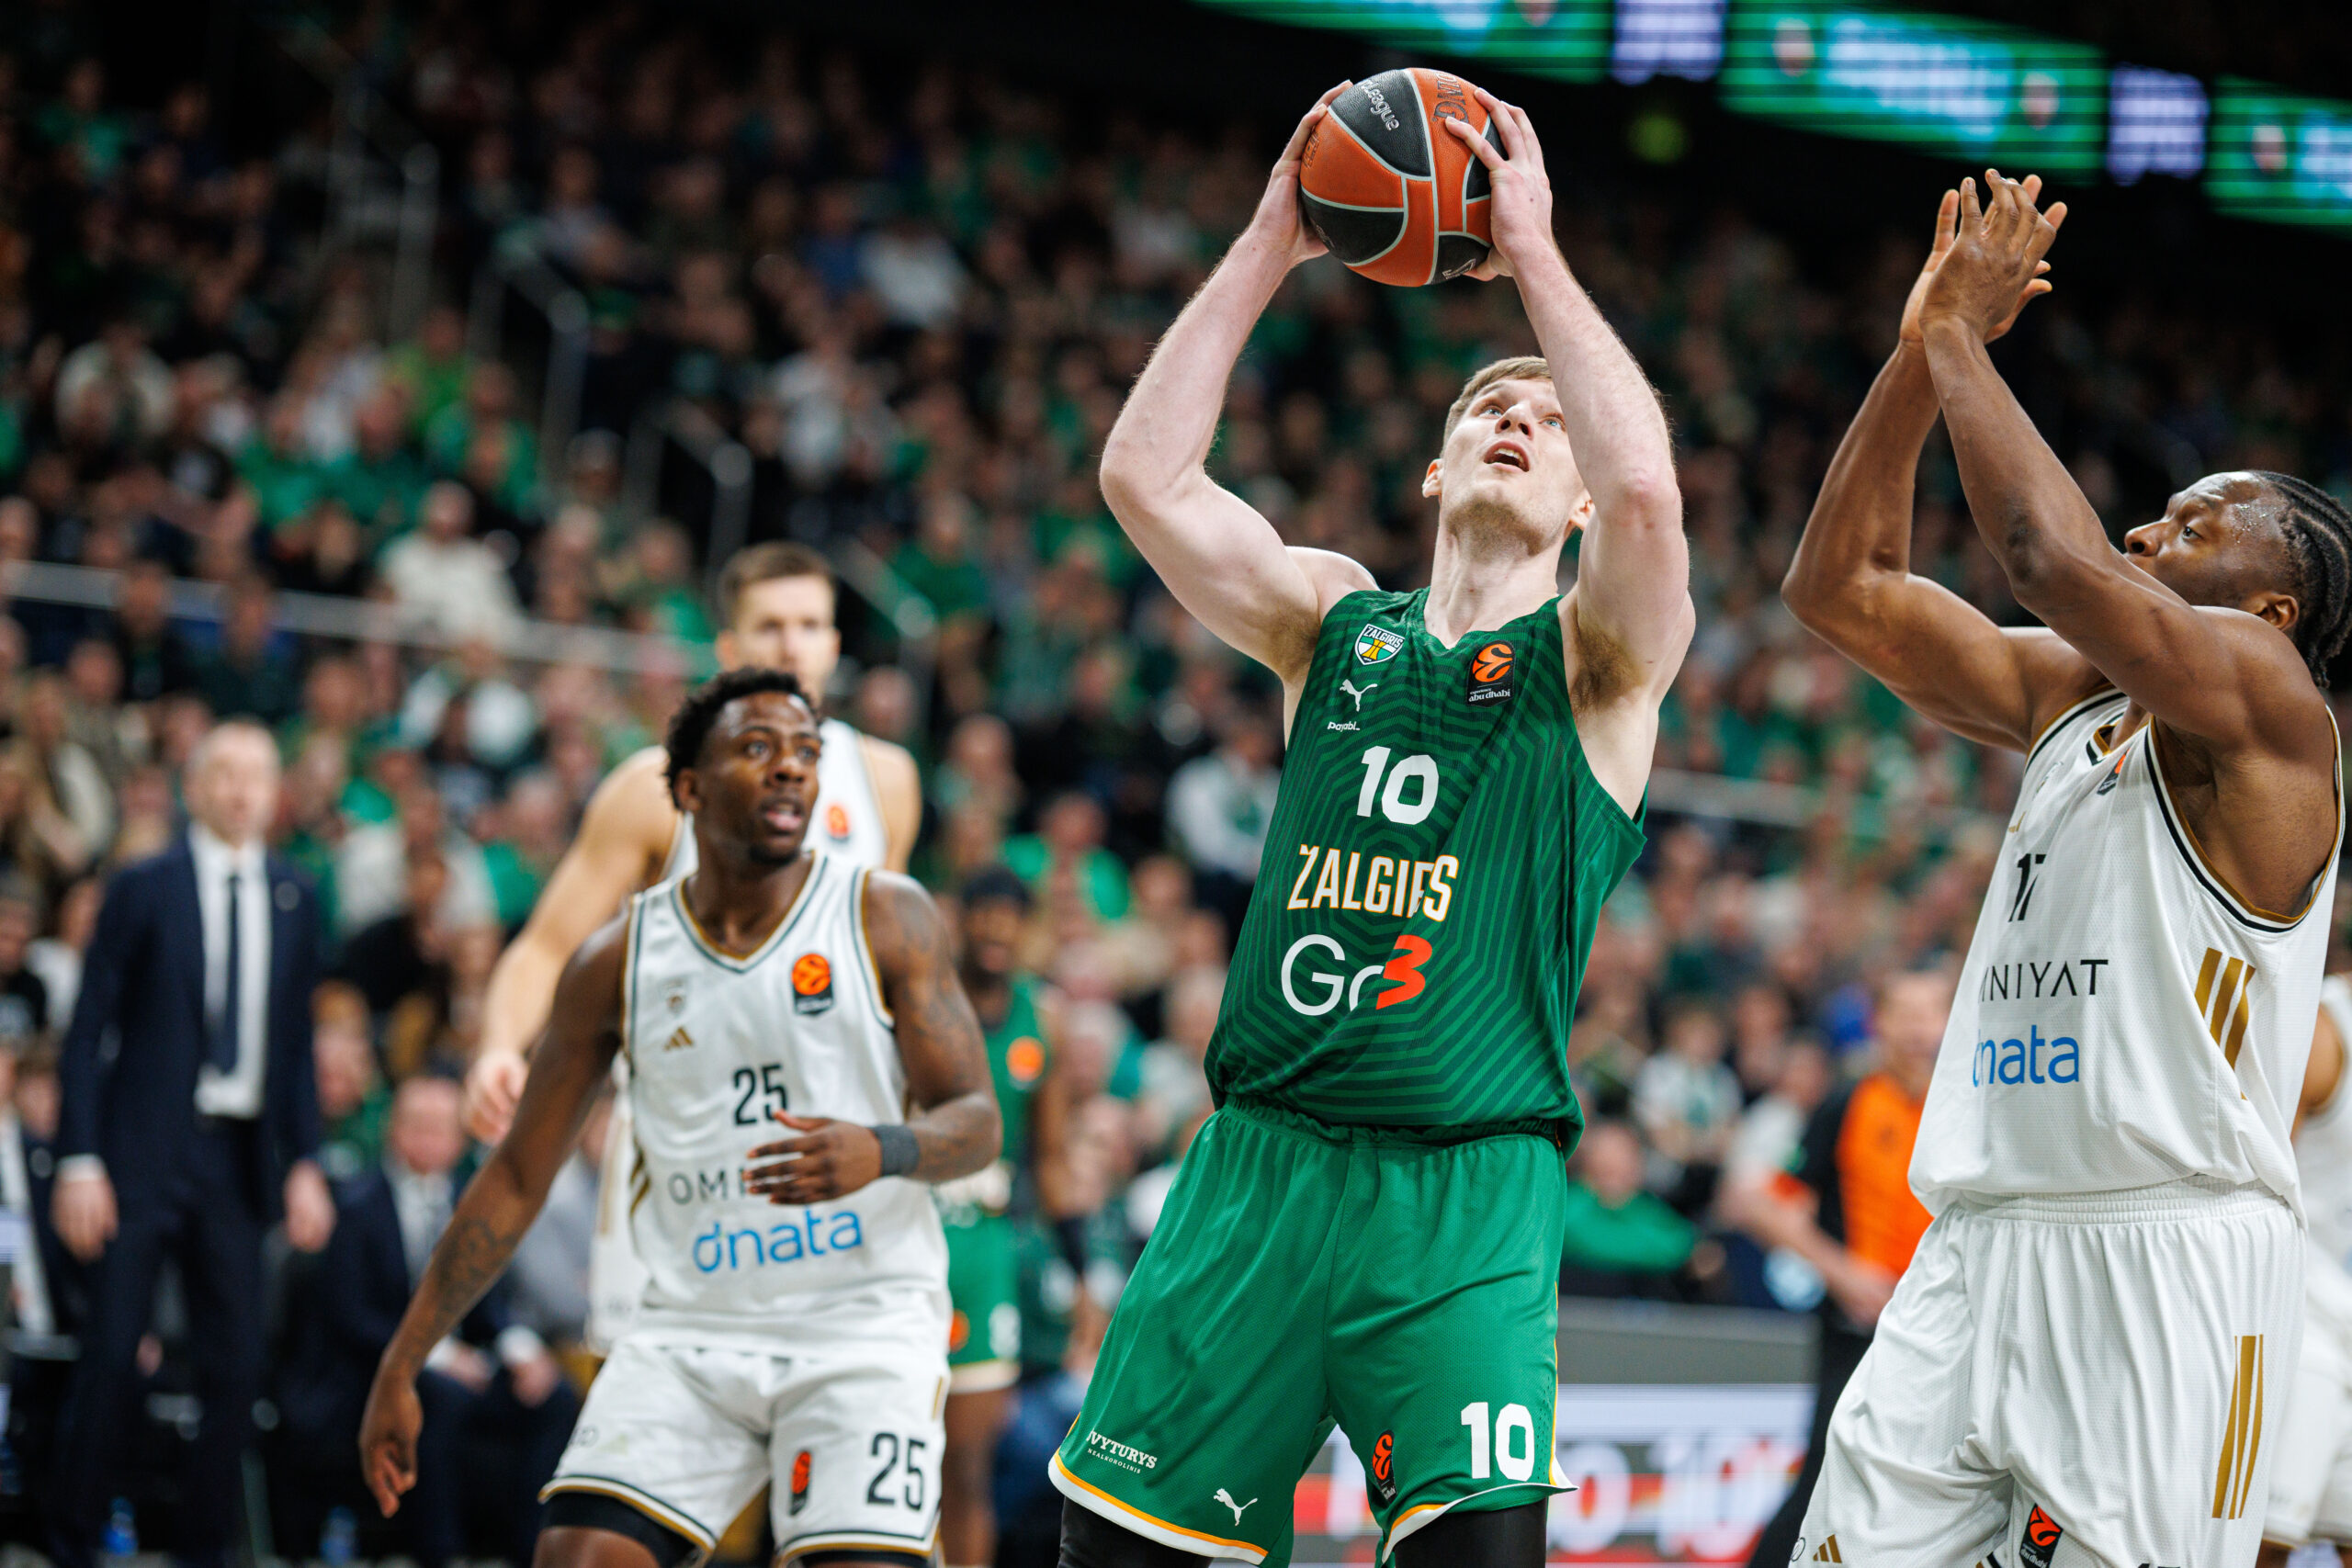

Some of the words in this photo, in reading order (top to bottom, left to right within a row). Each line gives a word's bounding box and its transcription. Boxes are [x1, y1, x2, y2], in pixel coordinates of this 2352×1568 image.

[1468, 694, 1485, 702] abu
[1485, 689, 1510, 699] dhabi
[1356, 745, 1440, 825] 10
[732, 1063, 789, 1126] 25
[692, 1205, 865, 1274] dnata
[866, 1432, 928, 1511] 25
[1460, 1402, 1535, 1482] 10
